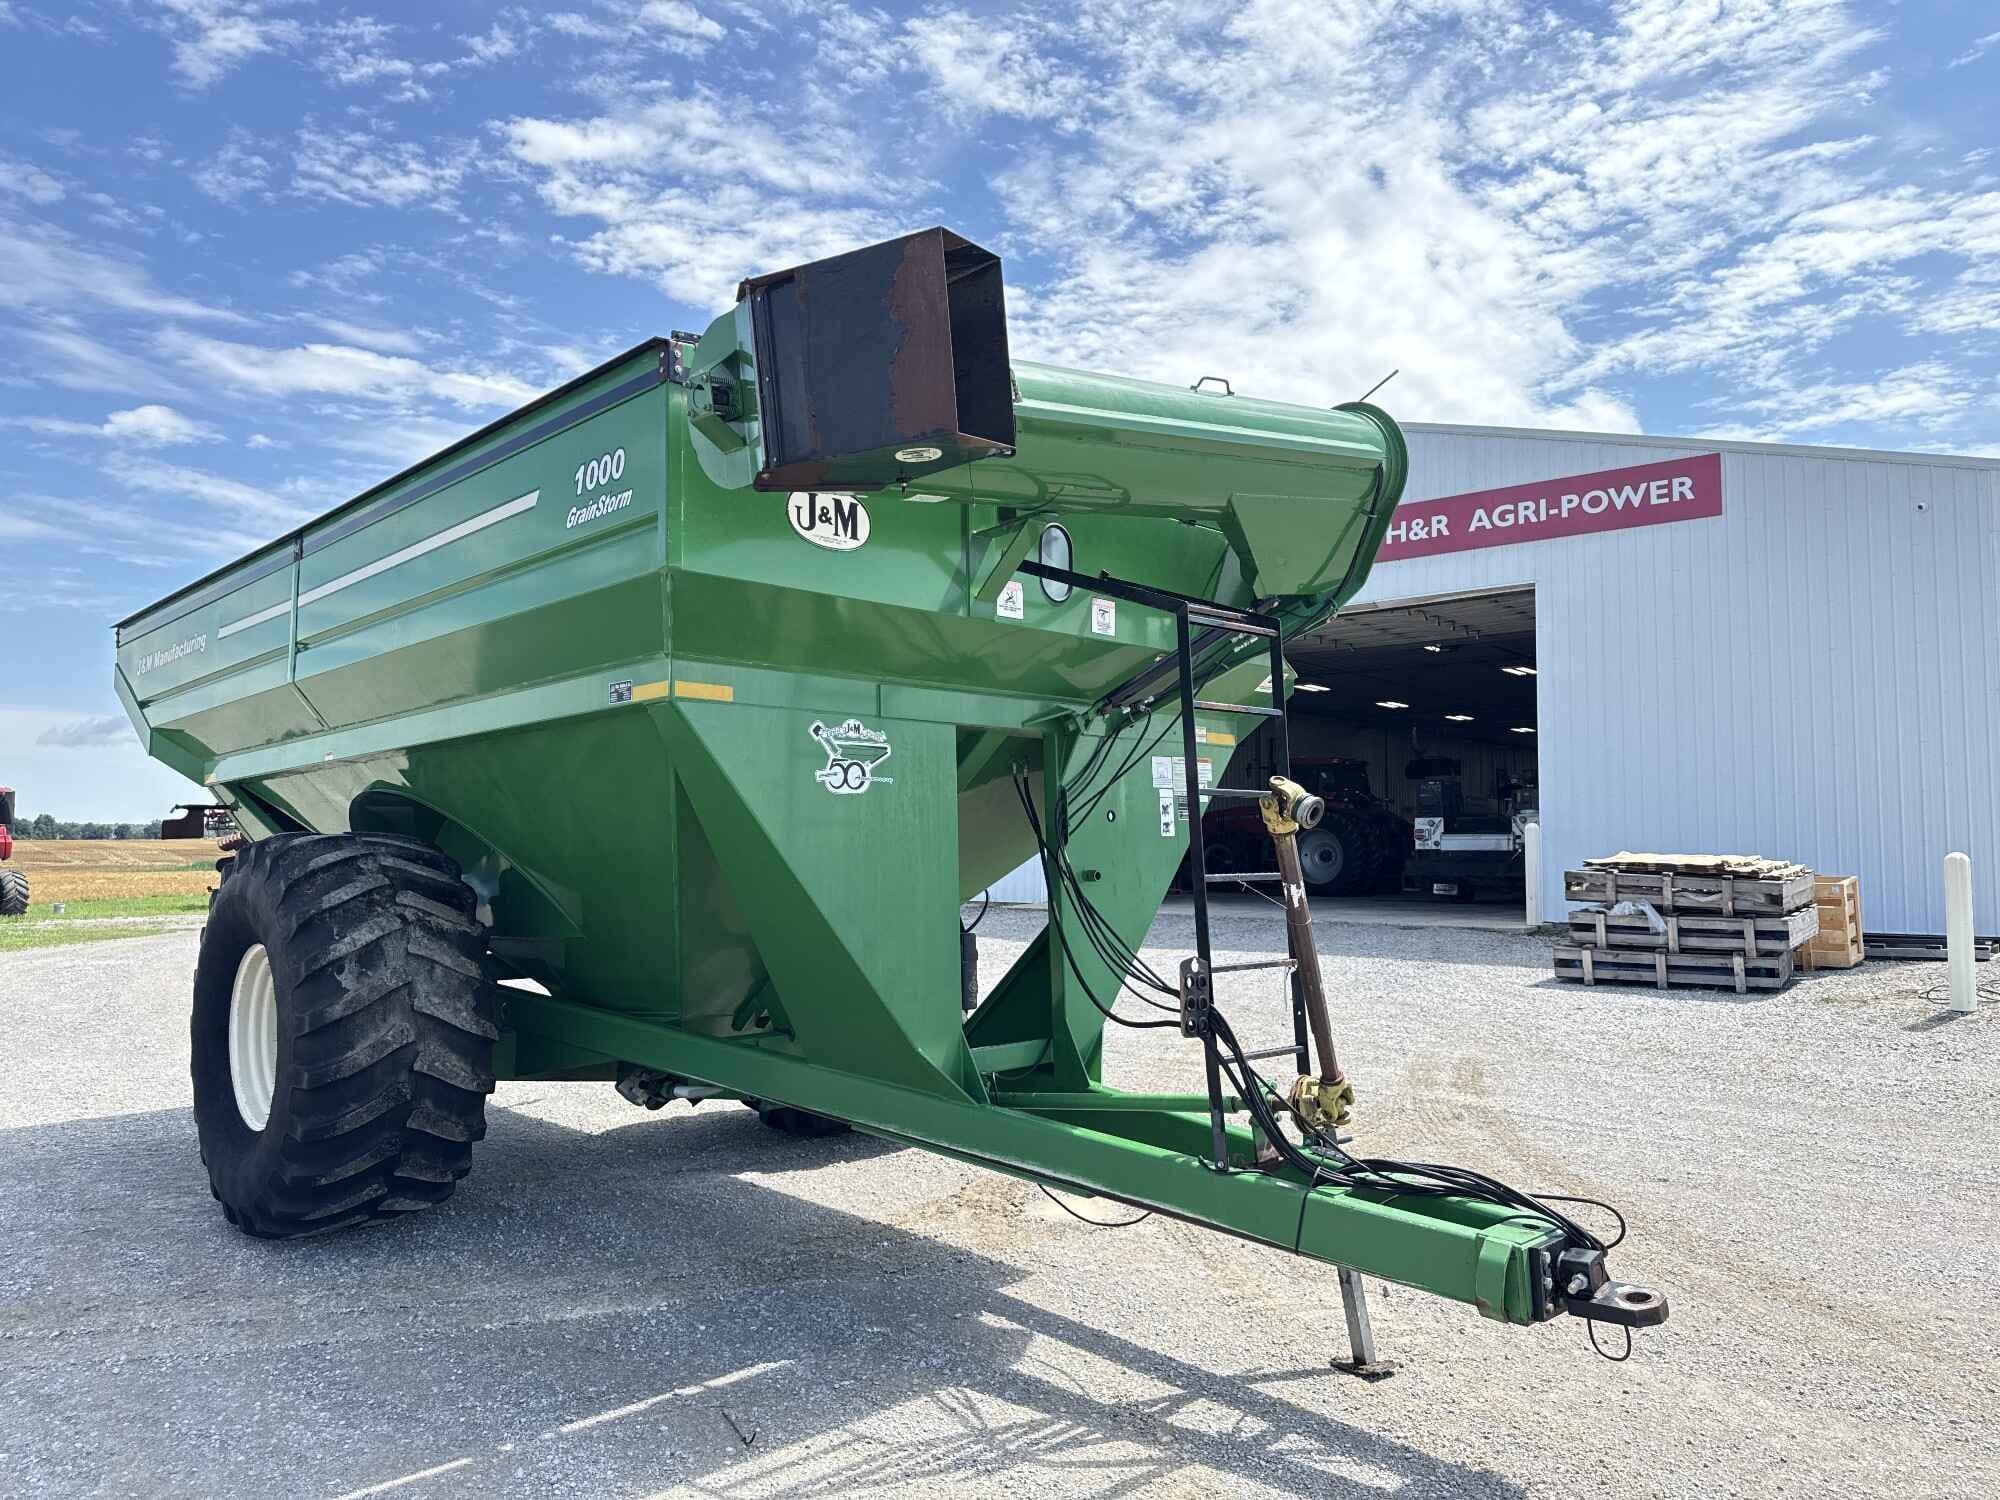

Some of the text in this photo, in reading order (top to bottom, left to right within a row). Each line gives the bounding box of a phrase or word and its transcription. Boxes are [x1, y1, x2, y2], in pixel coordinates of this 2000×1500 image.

[575, 448, 625, 495] 1000
[566, 489, 633, 528] GrainStorm
[795, 492, 860, 541] J&M
[1385, 476, 1695, 544] H&R AGRI-POWER
[154, 633, 207, 667] Manufacturing
